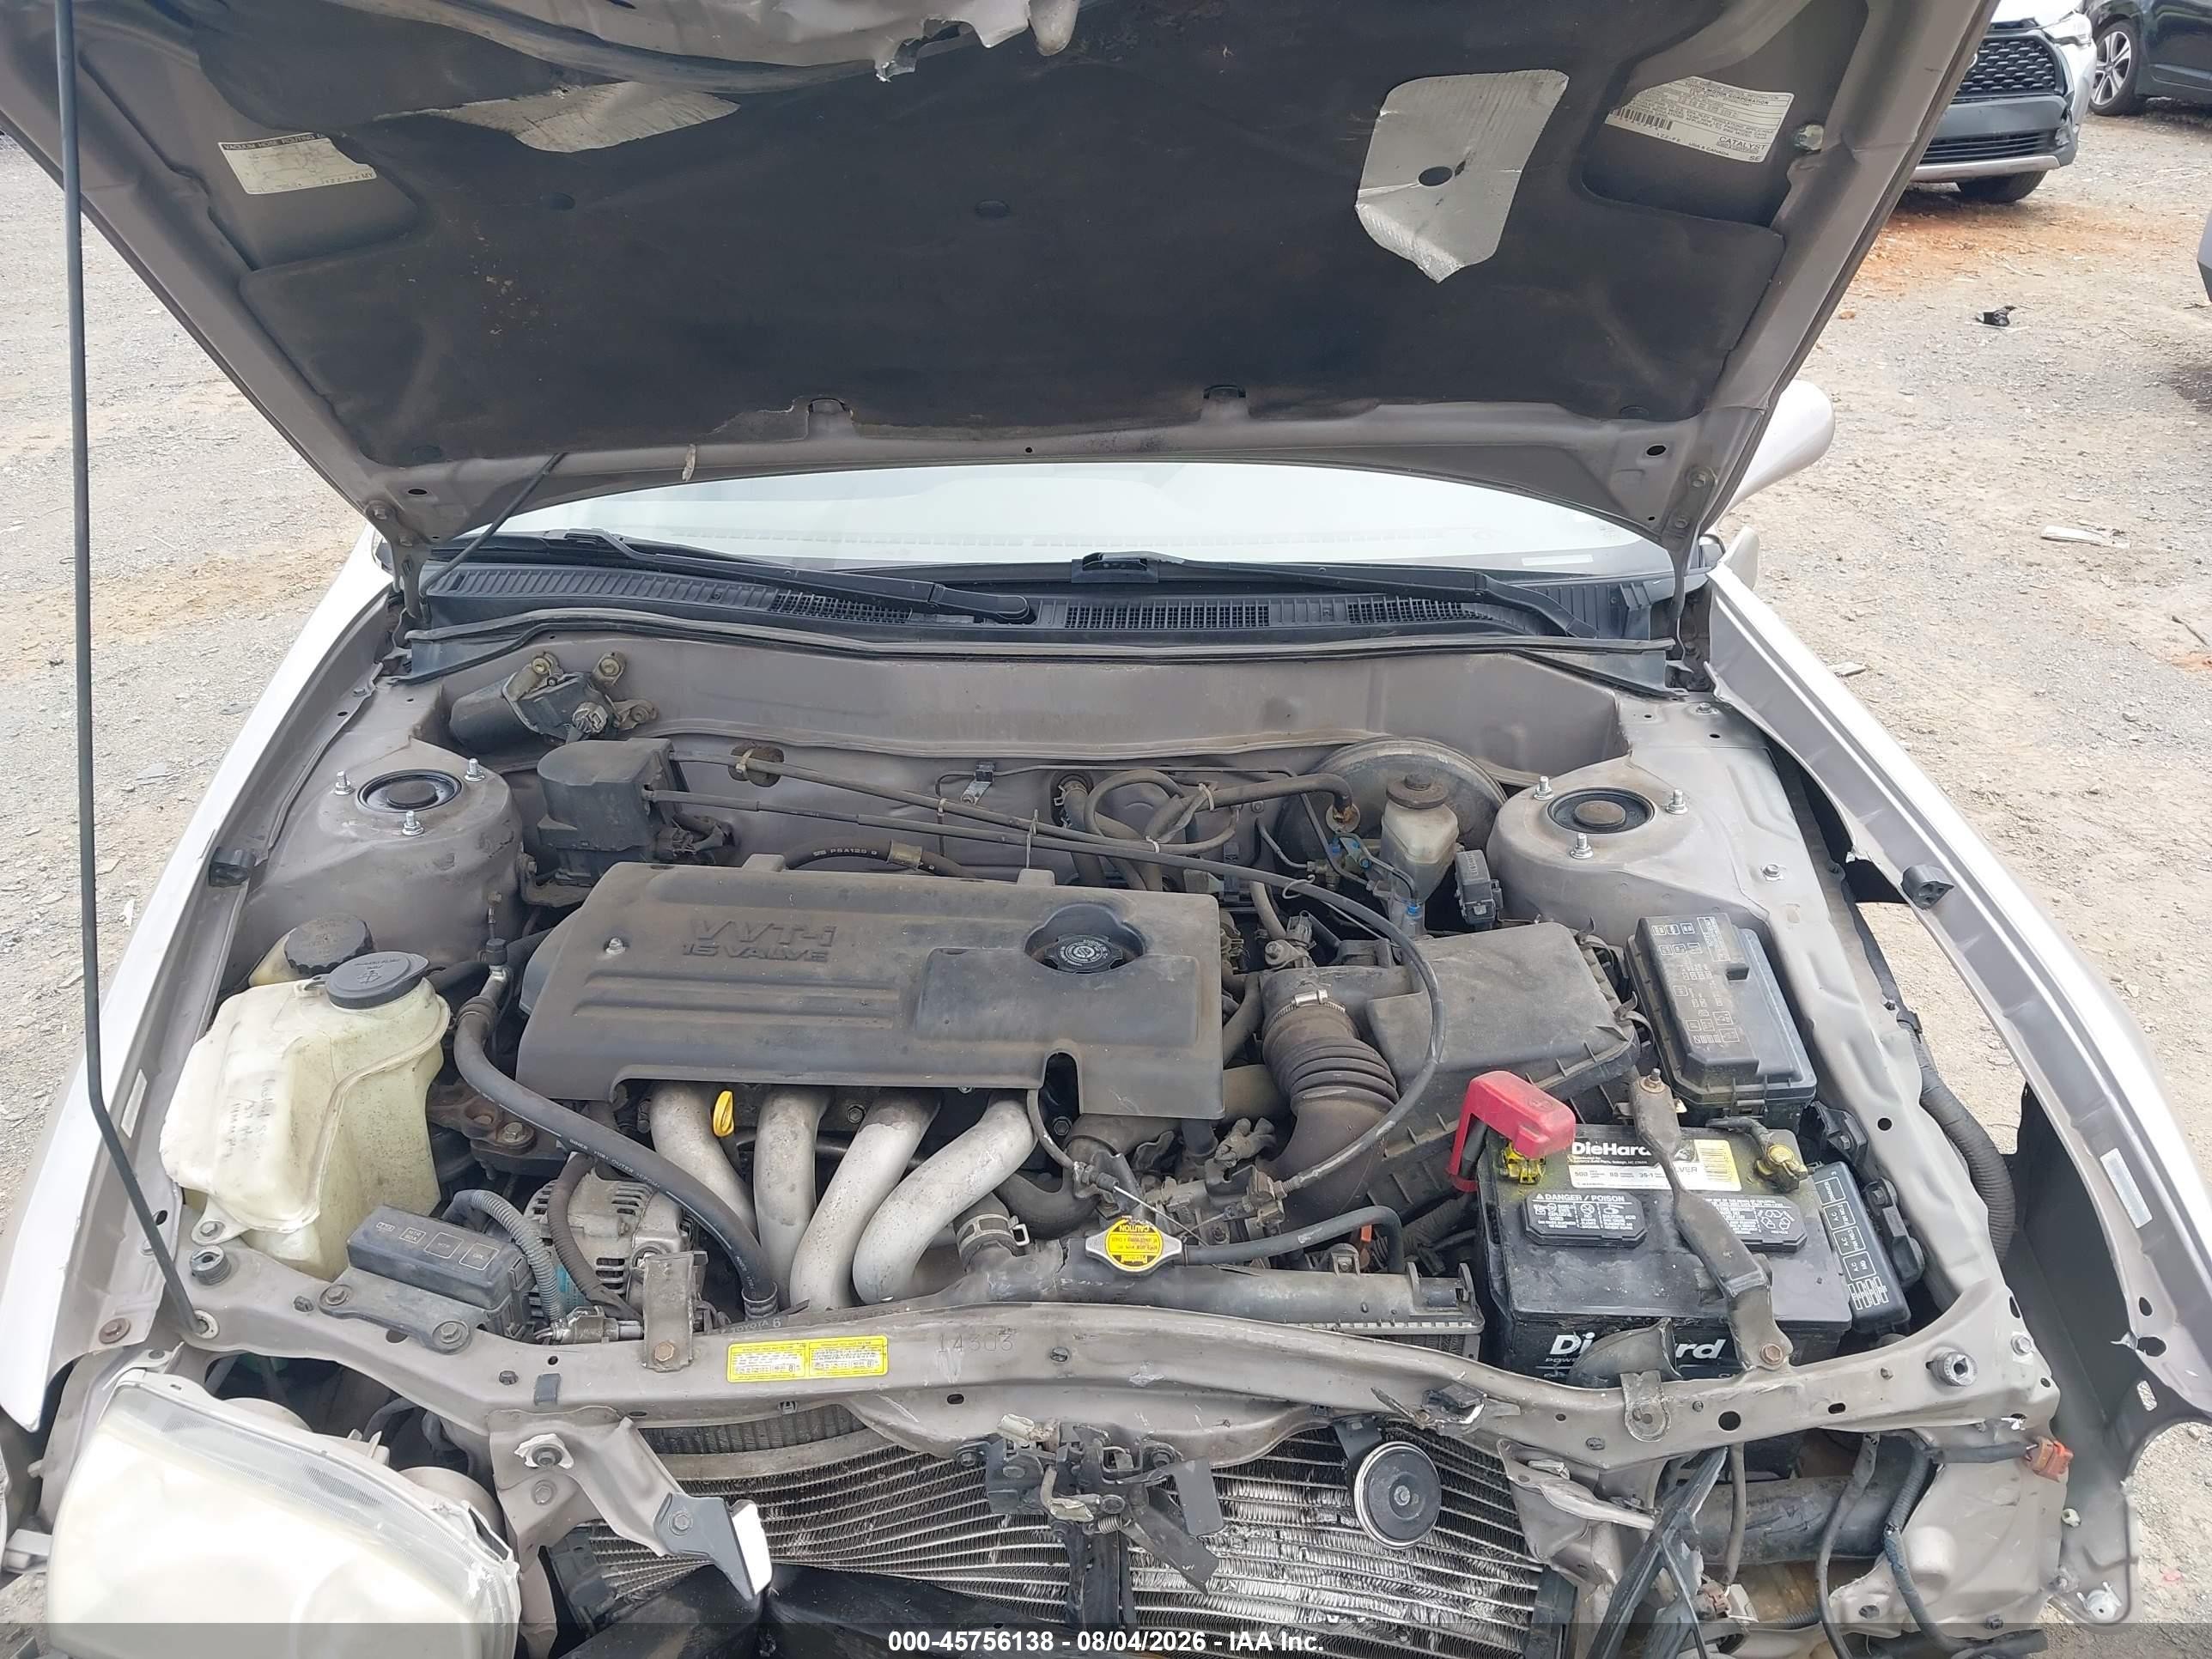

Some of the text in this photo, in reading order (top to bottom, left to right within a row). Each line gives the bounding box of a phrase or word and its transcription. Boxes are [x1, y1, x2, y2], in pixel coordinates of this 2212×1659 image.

[281, 135, 315, 144] ROUTING
[1719, 136, 1766, 151] CATALYST
[691, 920, 838, 947] VVT-i
[683, 943, 829, 963] 16 VALVE
[730, 1317, 781, 1333] TOYOTA 6
